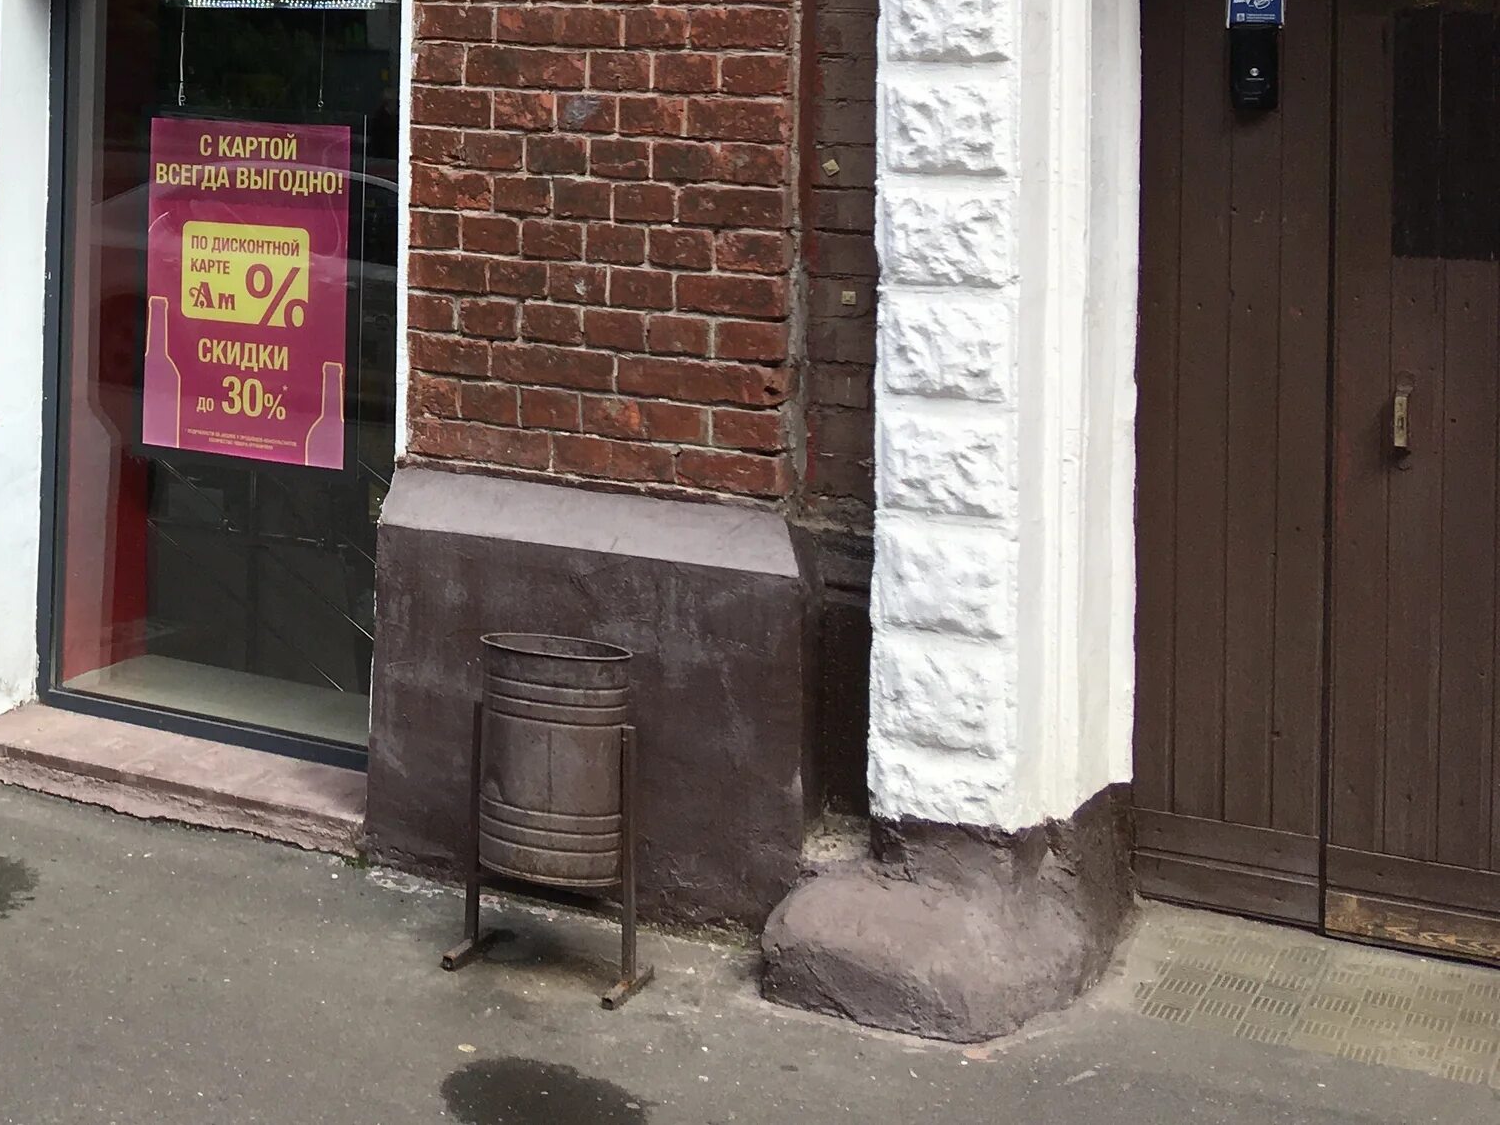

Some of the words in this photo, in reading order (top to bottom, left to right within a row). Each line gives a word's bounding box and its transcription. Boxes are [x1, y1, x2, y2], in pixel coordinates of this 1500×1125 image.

[200, 134, 212, 156] С
[218, 133, 297, 160] КАРТОЙ
[155, 163, 230, 191] ВСЕГДА
[236, 167, 344, 196] ВЫГОДНО!
[191, 235, 208, 250] ПО
[211, 236, 300, 257] ДИСКОНТНОЙ
[190, 258, 230, 275] КАРТЕ
[198, 338, 288, 372] СКИДКИ
